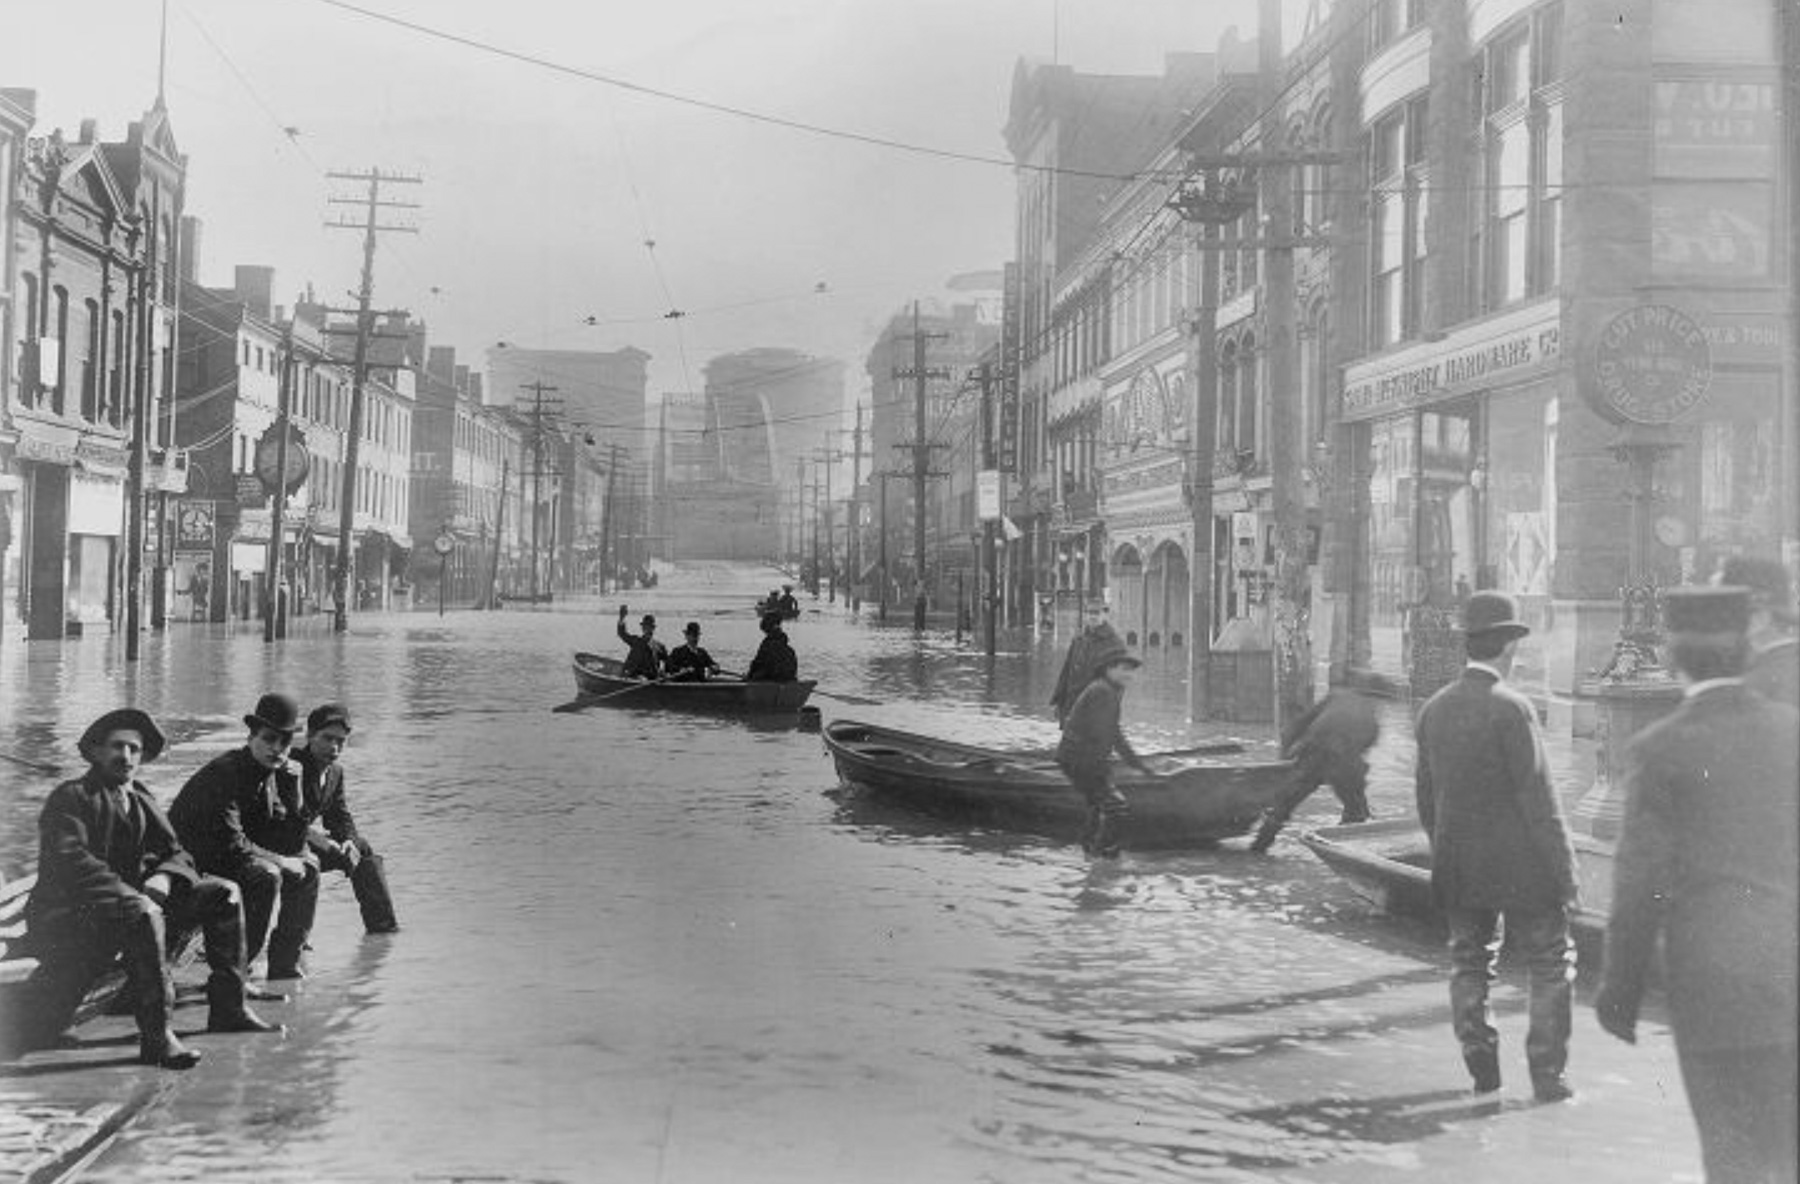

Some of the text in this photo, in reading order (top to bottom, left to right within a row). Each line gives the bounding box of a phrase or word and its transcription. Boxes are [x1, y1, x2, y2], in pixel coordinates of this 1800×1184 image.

[1605, 313, 1637, 349] CUT
[1643, 306, 1702, 349] PRICE
[1599, 361, 1641, 413] DRUG
